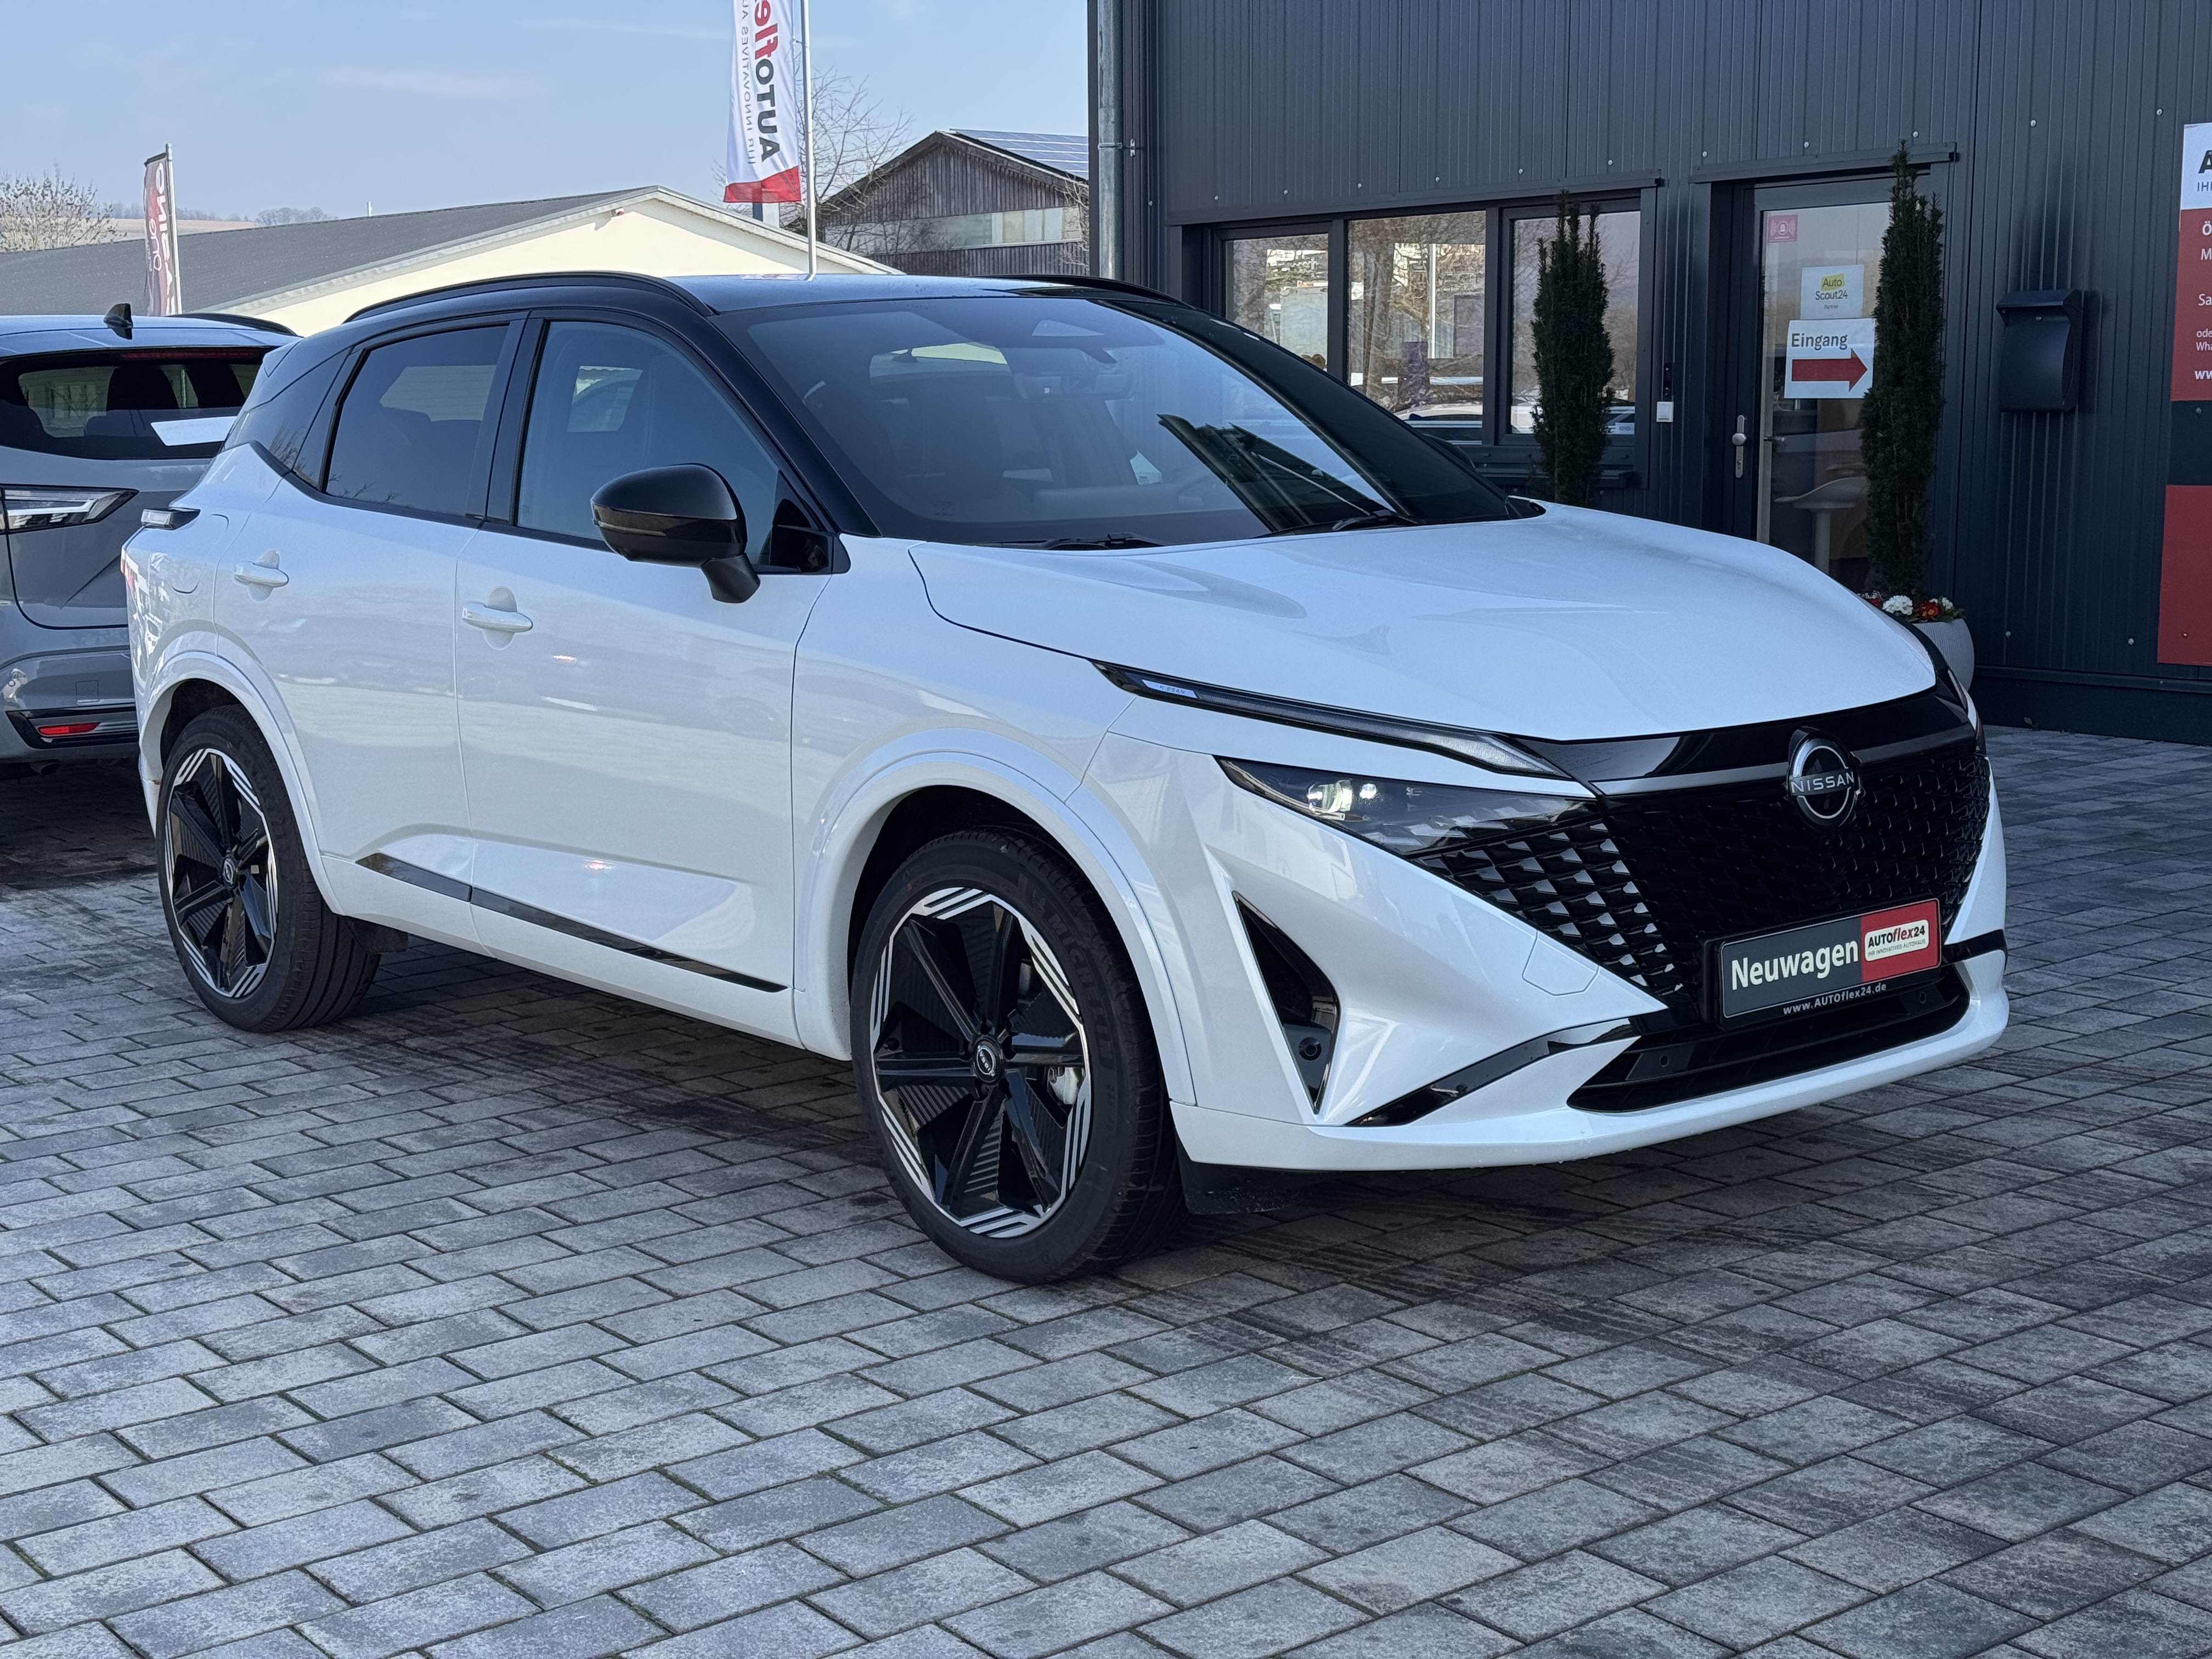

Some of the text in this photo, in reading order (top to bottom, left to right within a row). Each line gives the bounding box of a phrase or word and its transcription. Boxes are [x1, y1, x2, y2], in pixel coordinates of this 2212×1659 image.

[2198, 150, 2212, 174] A
[2197, 181, 2212, 191] IH
[2202, 221, 2212, 236] Ö
[2200, 247, 2212, 261] M
[1822, 278, 1842, 287] Auto
[1815, 289, 1848, 301] Scout24
[2198, 294, 2212, 306] Sa
[1791, 332, 1848, 351] Eingang
[1159, 685, 1186, 694] NISSAN
[1790, 771, 1855, 793] NISSAN
[1867, 925, 1926, 948] AUTOflex24
[1731, 940, 1859, 991] Neuwagen
[1048, 912, 1116, 1060] MICHELIN
[1783, 982, 1887, 1015] www.AUTOflex24.de
